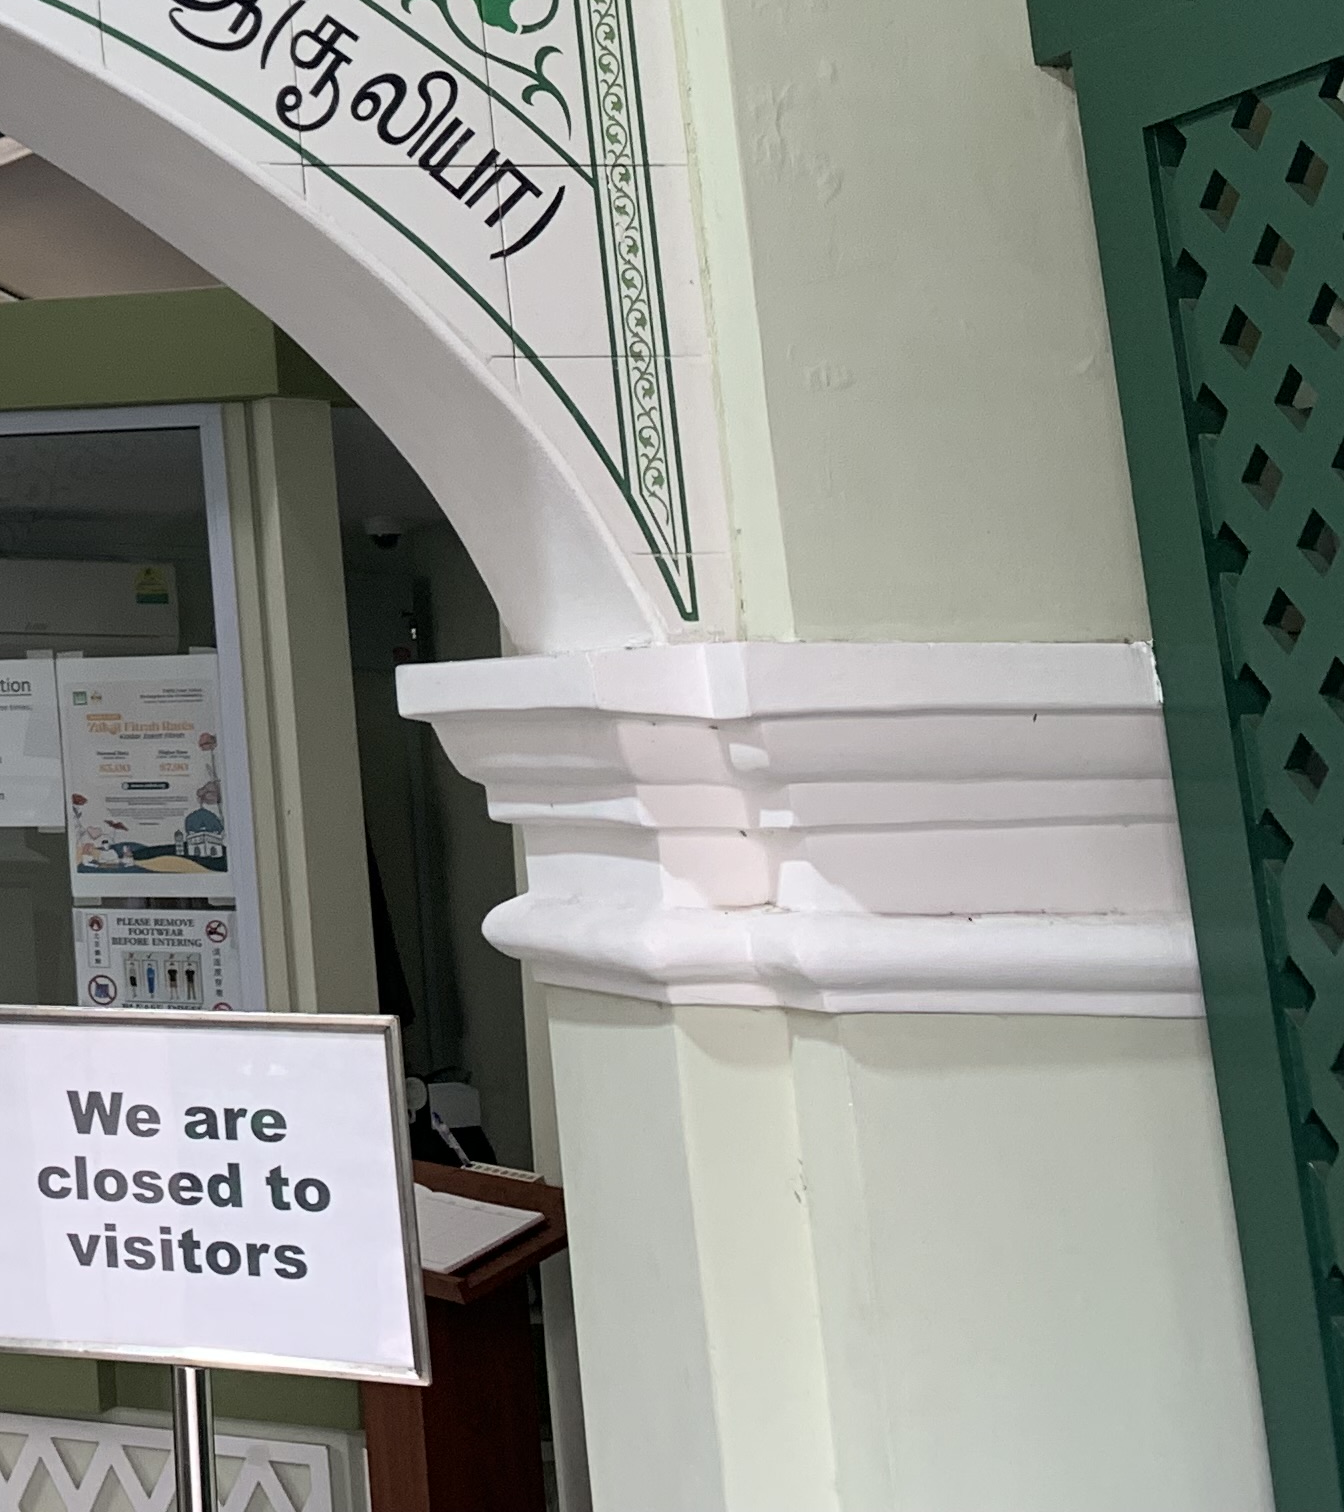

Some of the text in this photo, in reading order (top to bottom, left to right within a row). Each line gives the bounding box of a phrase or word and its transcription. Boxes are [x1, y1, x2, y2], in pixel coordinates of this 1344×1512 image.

[116, 917, 195, 928] PLEASE REMOVE
[127, 927, 184, 937] FOOTWEAR
[112, 936, 203, 948] BEFORE ENTERING
[66, 1090, 288, 1143] We are
[36, 1155, 332, 1213] closed to
[66, 1222, 309, 1280] visitors
